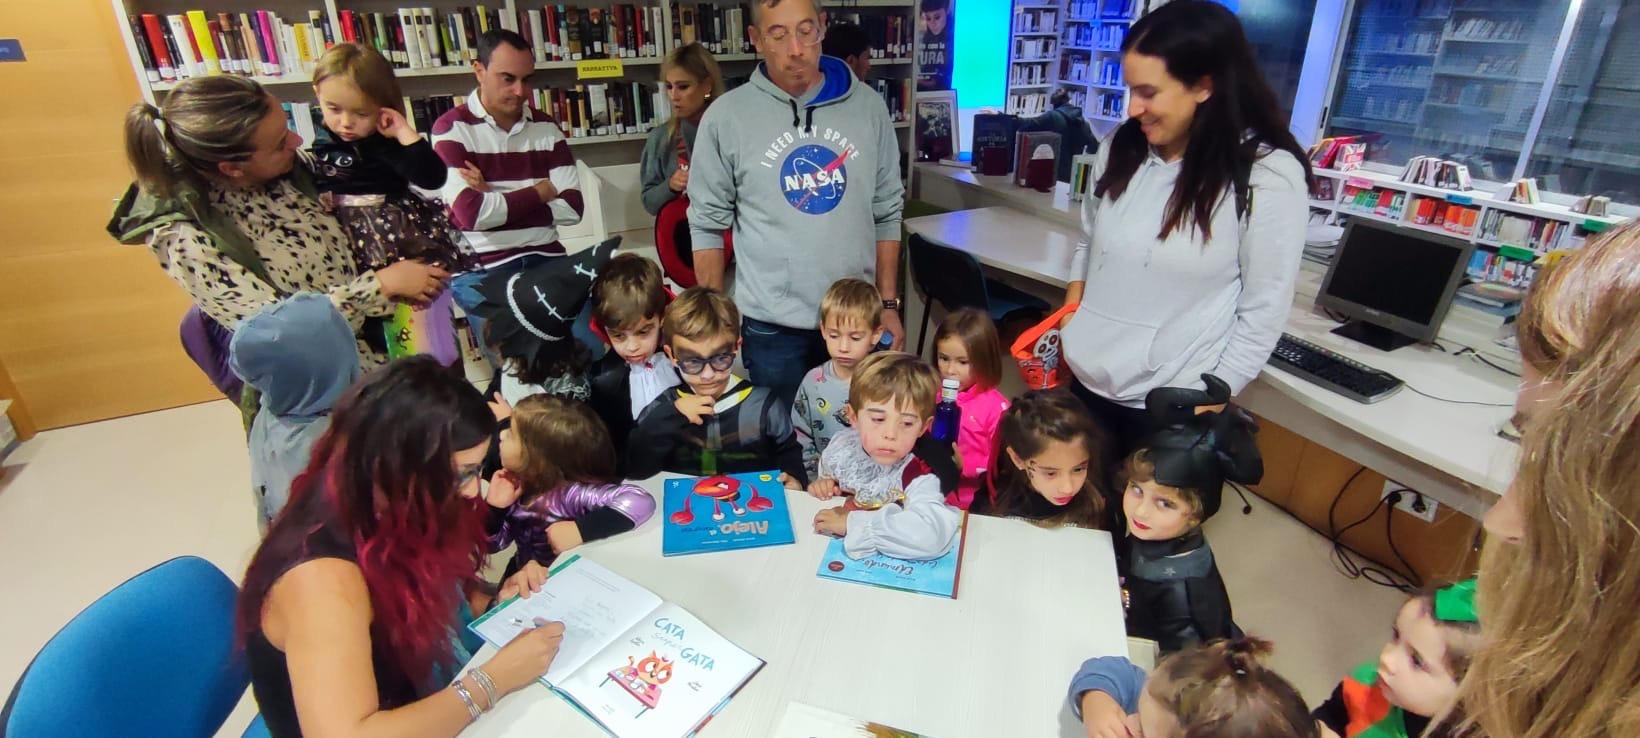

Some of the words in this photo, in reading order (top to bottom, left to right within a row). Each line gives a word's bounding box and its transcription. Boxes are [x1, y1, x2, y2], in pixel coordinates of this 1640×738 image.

[765, 131, 794, 161] NEED
[797, 124, 818, 139] MY
[823, 127, 860, 160] SPACE
[784, 168, 845, 192] NASA
[654, 617, 686, 640] CATA
[680, 647, 715, 672] GATA
